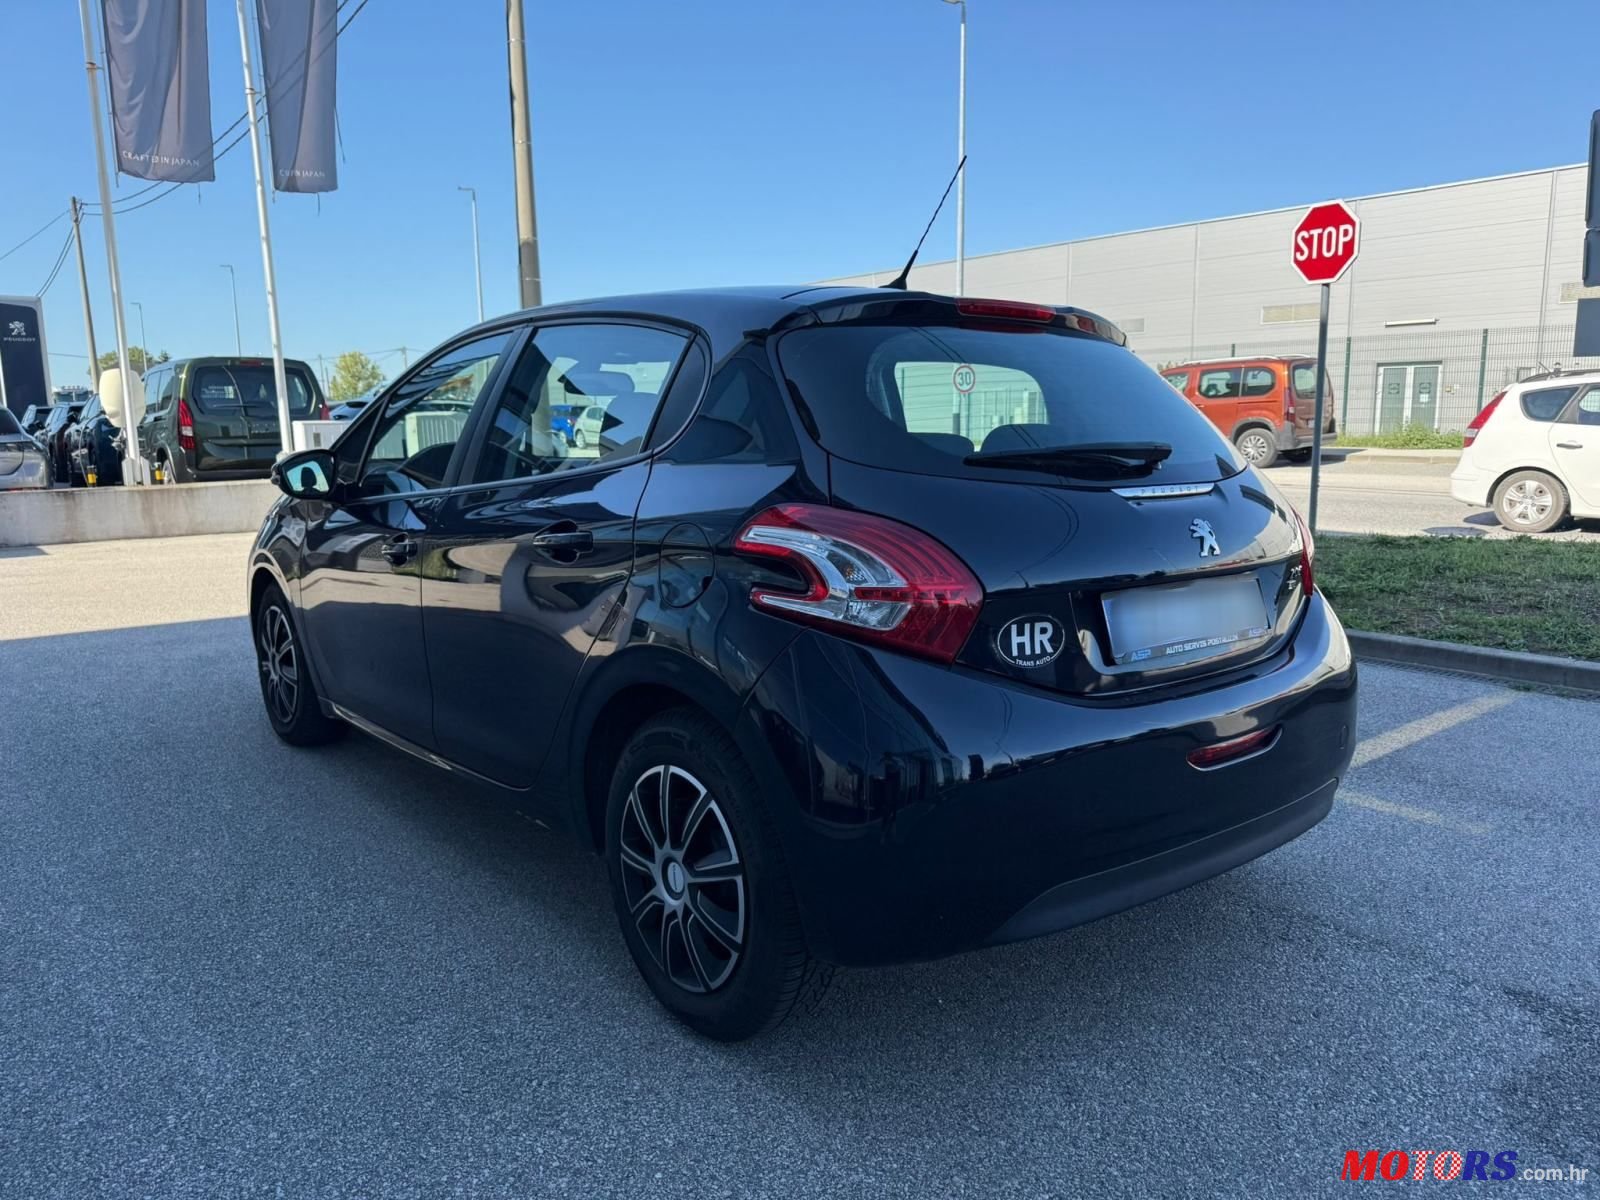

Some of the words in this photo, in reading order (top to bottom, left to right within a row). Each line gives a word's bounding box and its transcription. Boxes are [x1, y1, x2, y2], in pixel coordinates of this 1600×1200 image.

[161, 156, 169, 164] IN
[171, 156, 200, 168] JAPAN
[302, 169, 326, 178] JAPAN
[1295, 223, 1354, 262] STOP
[957, 371, 972, 387] 30
[1141, 486, 1199, 495] PEUGEOT
[1010, 621, 1054, 657] HR
[1131, 649, 1151, 662] ASP
[1166, 646, 1184, 656] AUTO
[1184, 641, 1207, 652] SERVIS
[1016, 659, 1035, 667] TRANS
[1036, 655, 1052, 666] AUTO
